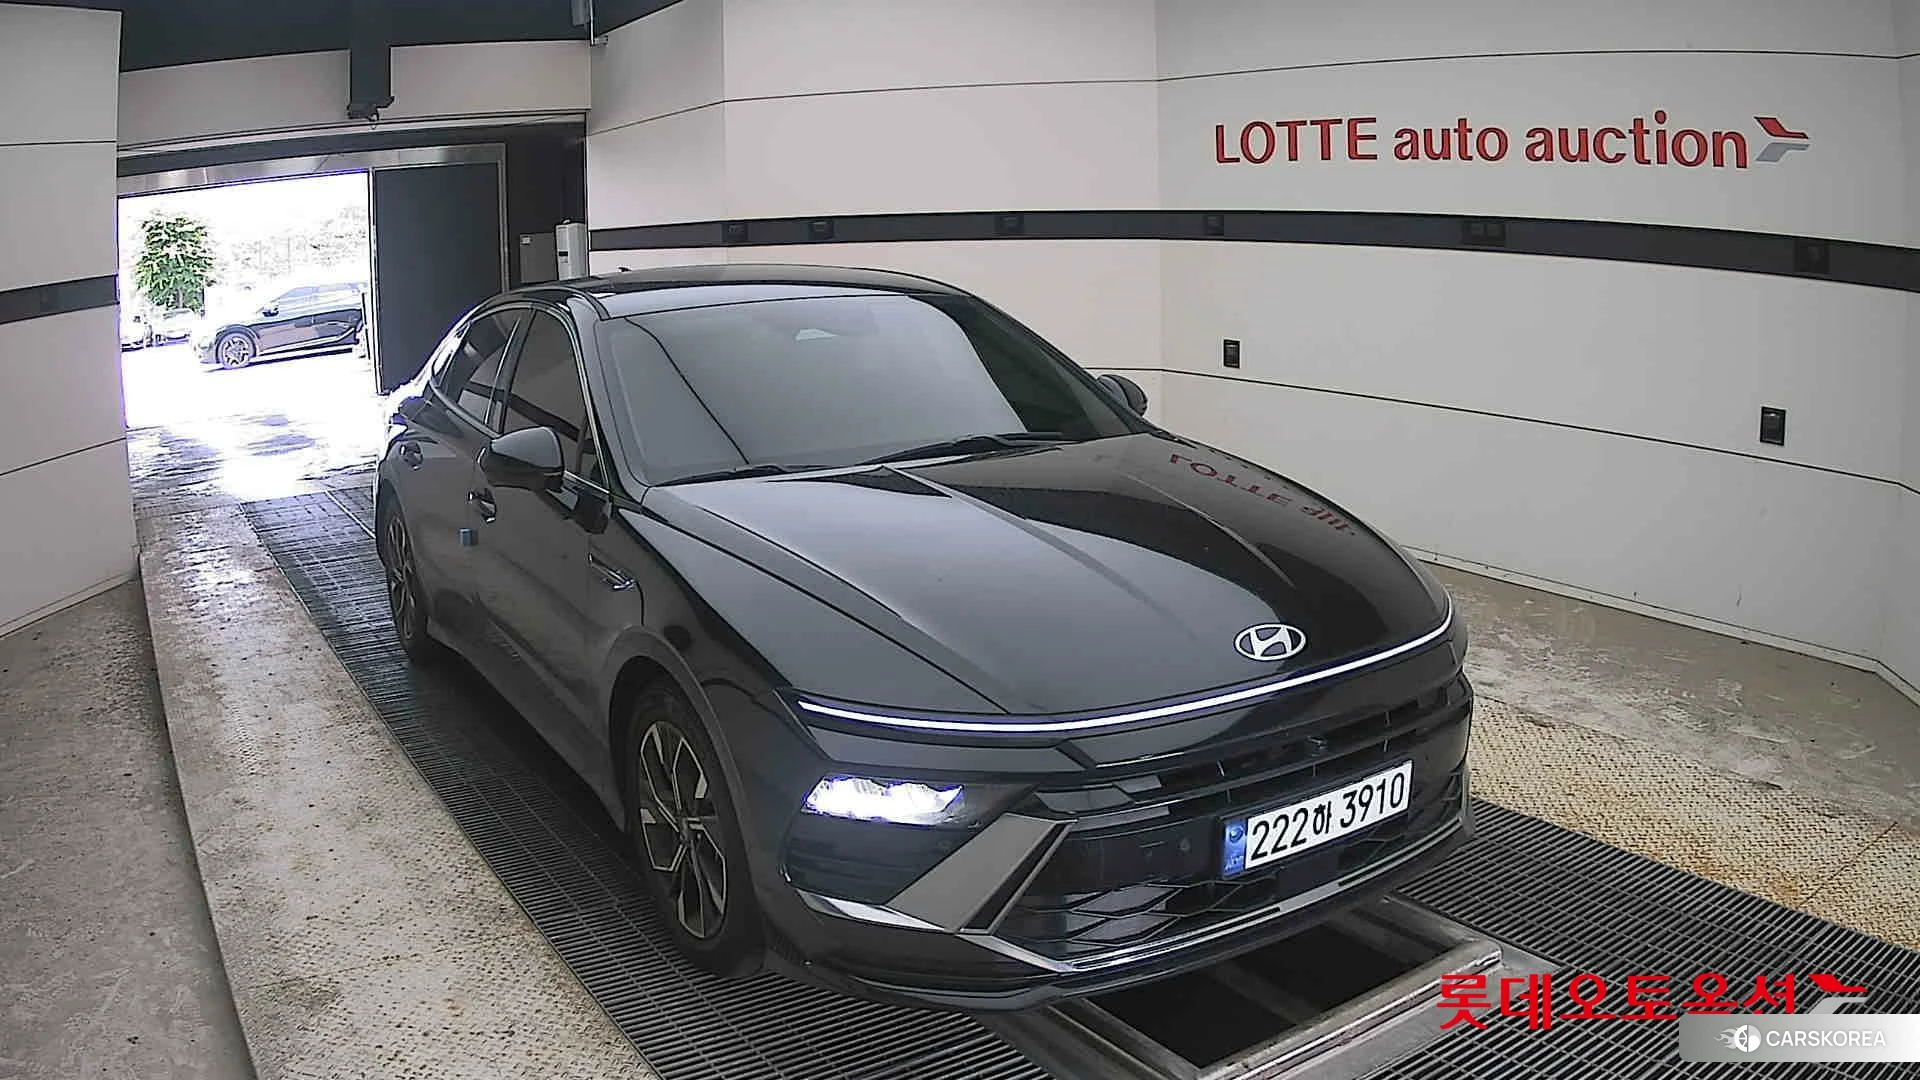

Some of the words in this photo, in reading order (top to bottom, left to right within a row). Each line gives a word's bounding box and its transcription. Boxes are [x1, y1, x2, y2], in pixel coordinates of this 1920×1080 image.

[1215, 117, 1378, 164] LOTTE
[1393, 118, 1509, 161] auto
[1525, 109, 1748, 168] auction
[1250, 801, 1333, 861] 222하
[1340, 772, 1406, 828] 3910
